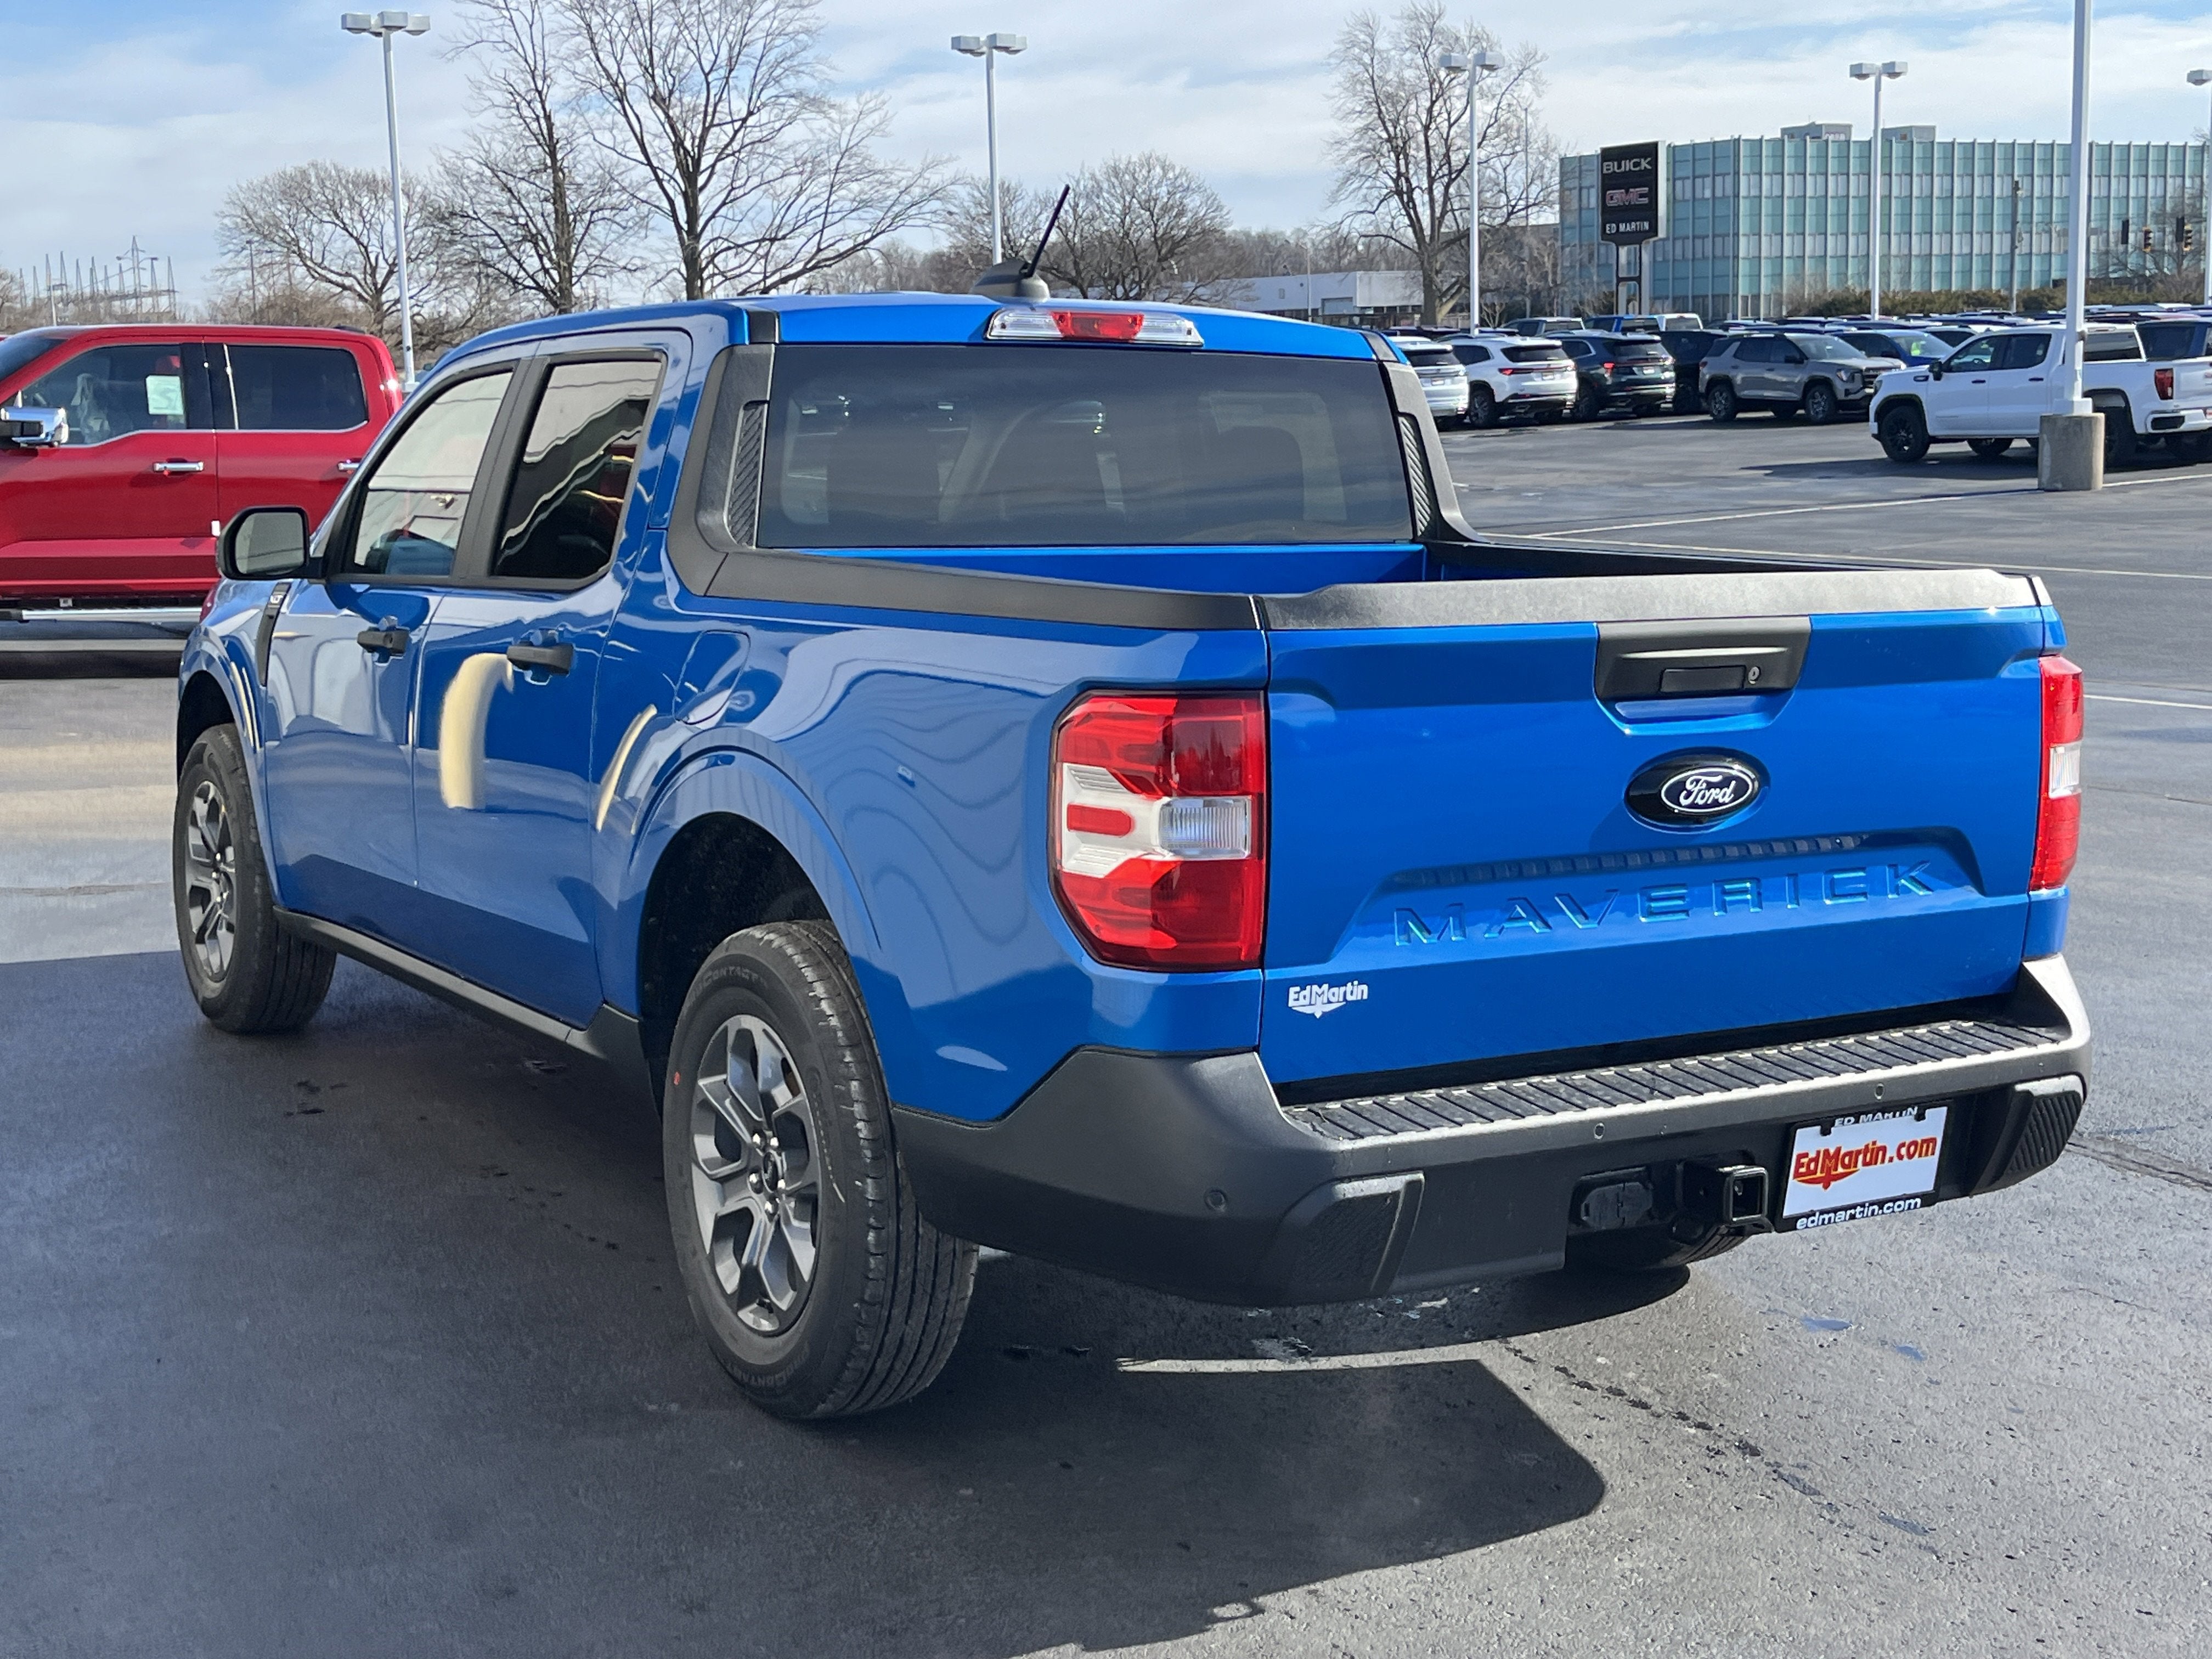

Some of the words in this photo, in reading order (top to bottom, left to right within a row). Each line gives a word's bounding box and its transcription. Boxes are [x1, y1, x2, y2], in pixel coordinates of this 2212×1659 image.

[1602, 157, 1652, 174] BUICK
[1605, 187, 1649, 207] GMC
[1605, 223, 1617, 234] ED
[1618, 221, 1649, 233] MARTIN
[1679, 775, 1736, 806] Ford
[1394, 860, 1934, 946] MAVERICK
[1288, 980, 1368, 1008] EdMartin
[1792, 1137, 1937, 1182] EdMartin.com
[1796, 1197, 1921, 1229] edmartin.com
